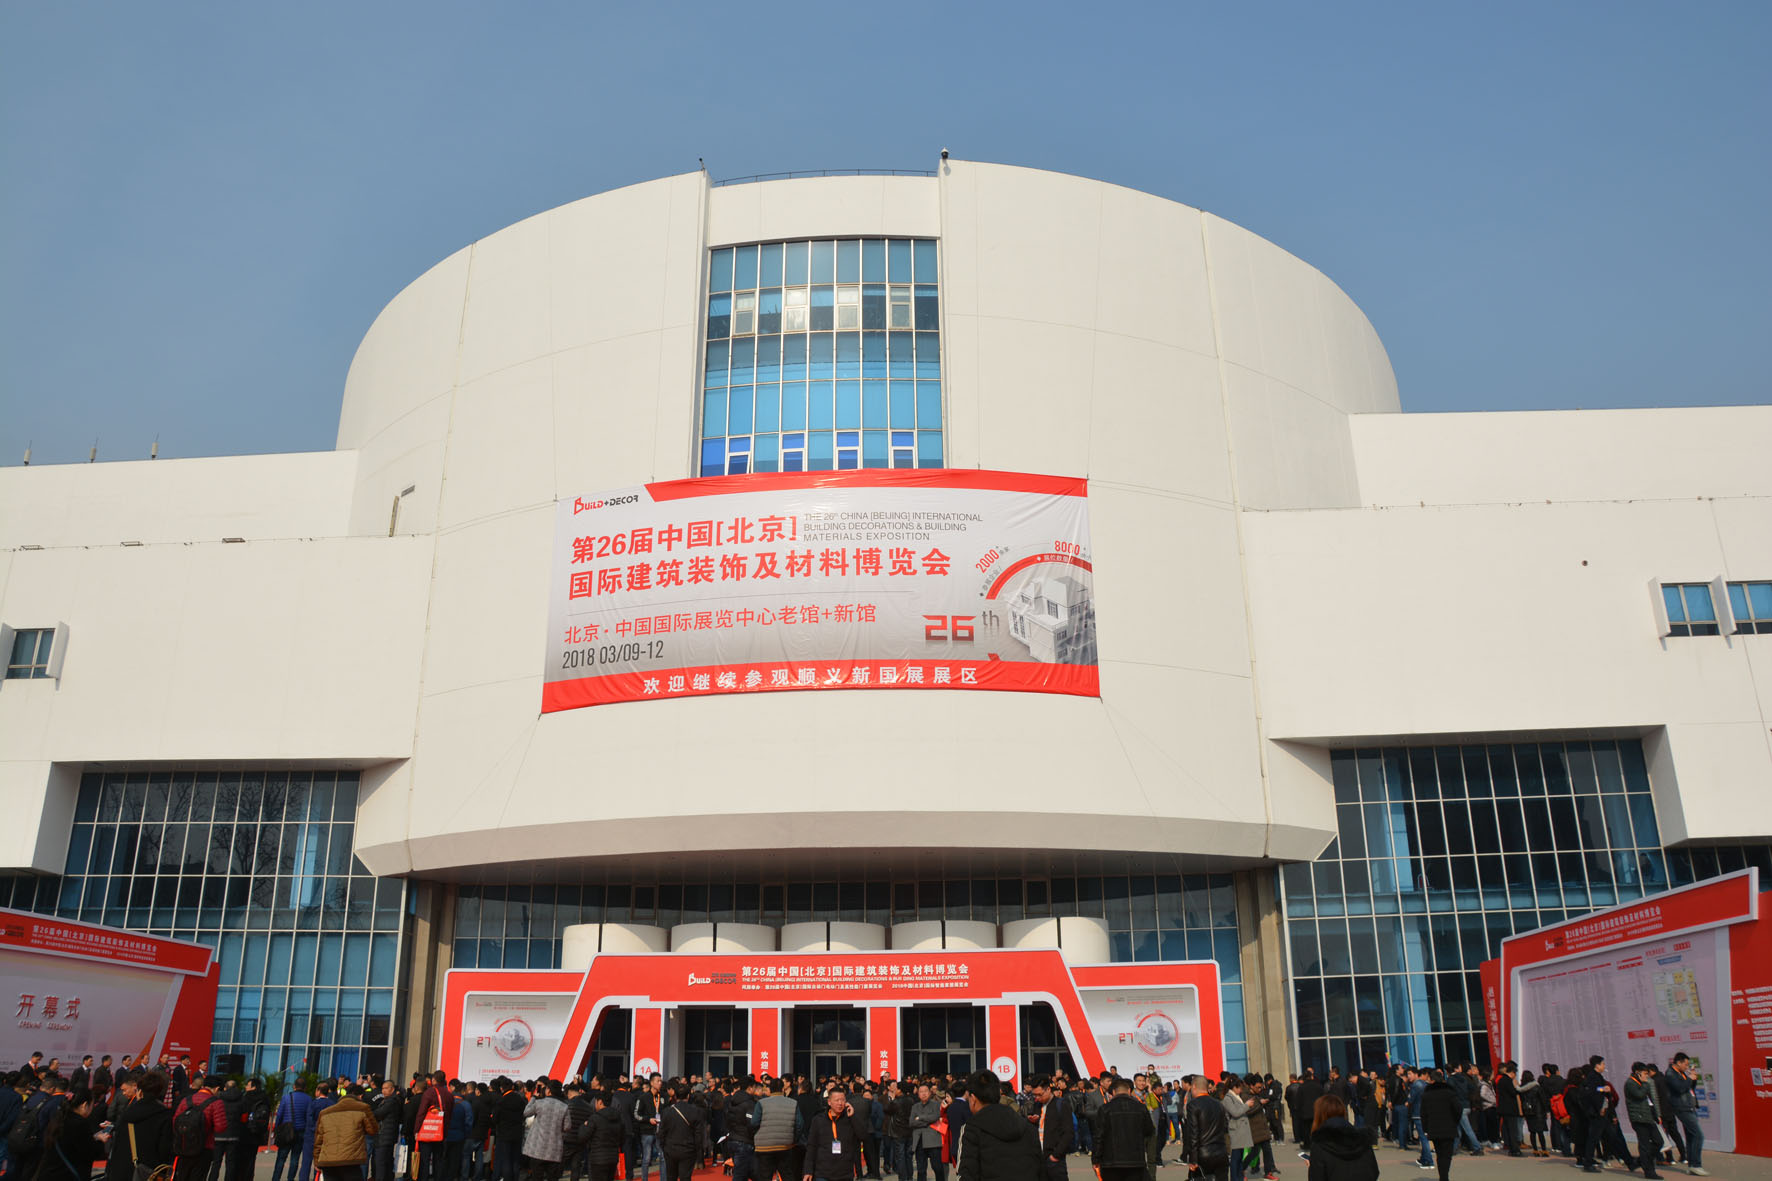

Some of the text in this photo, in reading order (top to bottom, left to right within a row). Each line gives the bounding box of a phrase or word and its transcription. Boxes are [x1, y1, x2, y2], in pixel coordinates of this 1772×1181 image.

[804, 513, 821, 521] THE
[840, 512, 869, 520] CHINA
[870, 511, 911, 521] [BEIJING]
[912, 511, 983, 522] INTERNATIONAL
[803, 521, 967, 531] BUILDING DECORATIONS & BUILDING
[570, 514, 797, 565] 第26届中国[北京]
[803, 532, 930, 542] MATERIALS EXPOSITION
[1054, 540, 1080, 556] 8000
[975, 548, 1000, 574] 2000
[569, 547, 951, 600] 国际建筑装饰及材料博览会
[562, 640, 664, 669] 2018 03/09-12
[643, 665, 978, 694] 欢迎继续参观顺义新国展展区
[741, 963, 969, 977] 第26届中国[北京]国际建筑装饰及材料博览会
[15, 992, 81, 1020] 开幕式
[640, 1065, 652, 1075] 1A
[997, 1064, 1011, 1074] 1B
